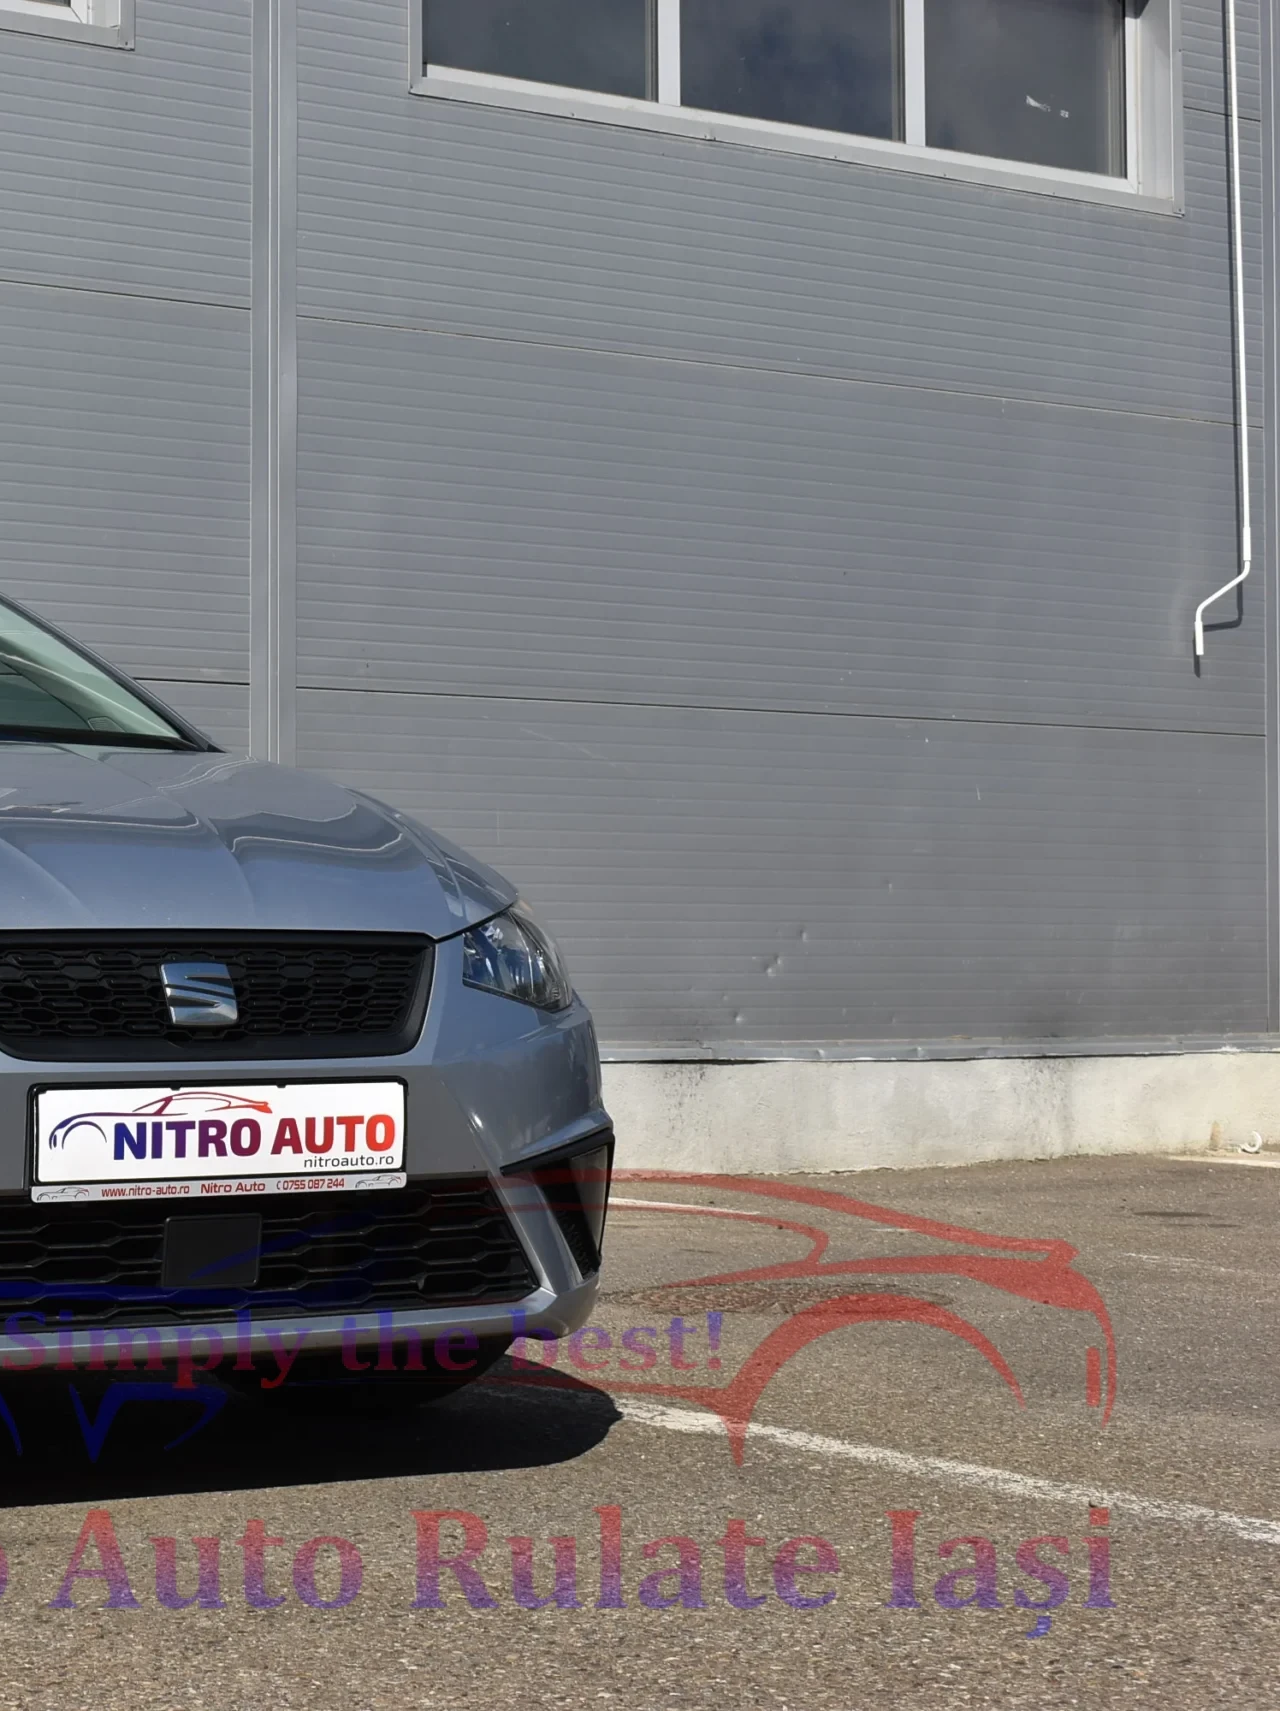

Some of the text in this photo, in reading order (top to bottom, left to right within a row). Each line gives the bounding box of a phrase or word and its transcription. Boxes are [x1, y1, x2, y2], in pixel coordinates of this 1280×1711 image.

[114, 1115, 395, 1160] NITRO AUTO
[304, 1154, 394, 1168] nitroauto.ro
[101, 1178, 345, 1197] www.nitro-auto.ro Nitro Auto 0755 087 244
